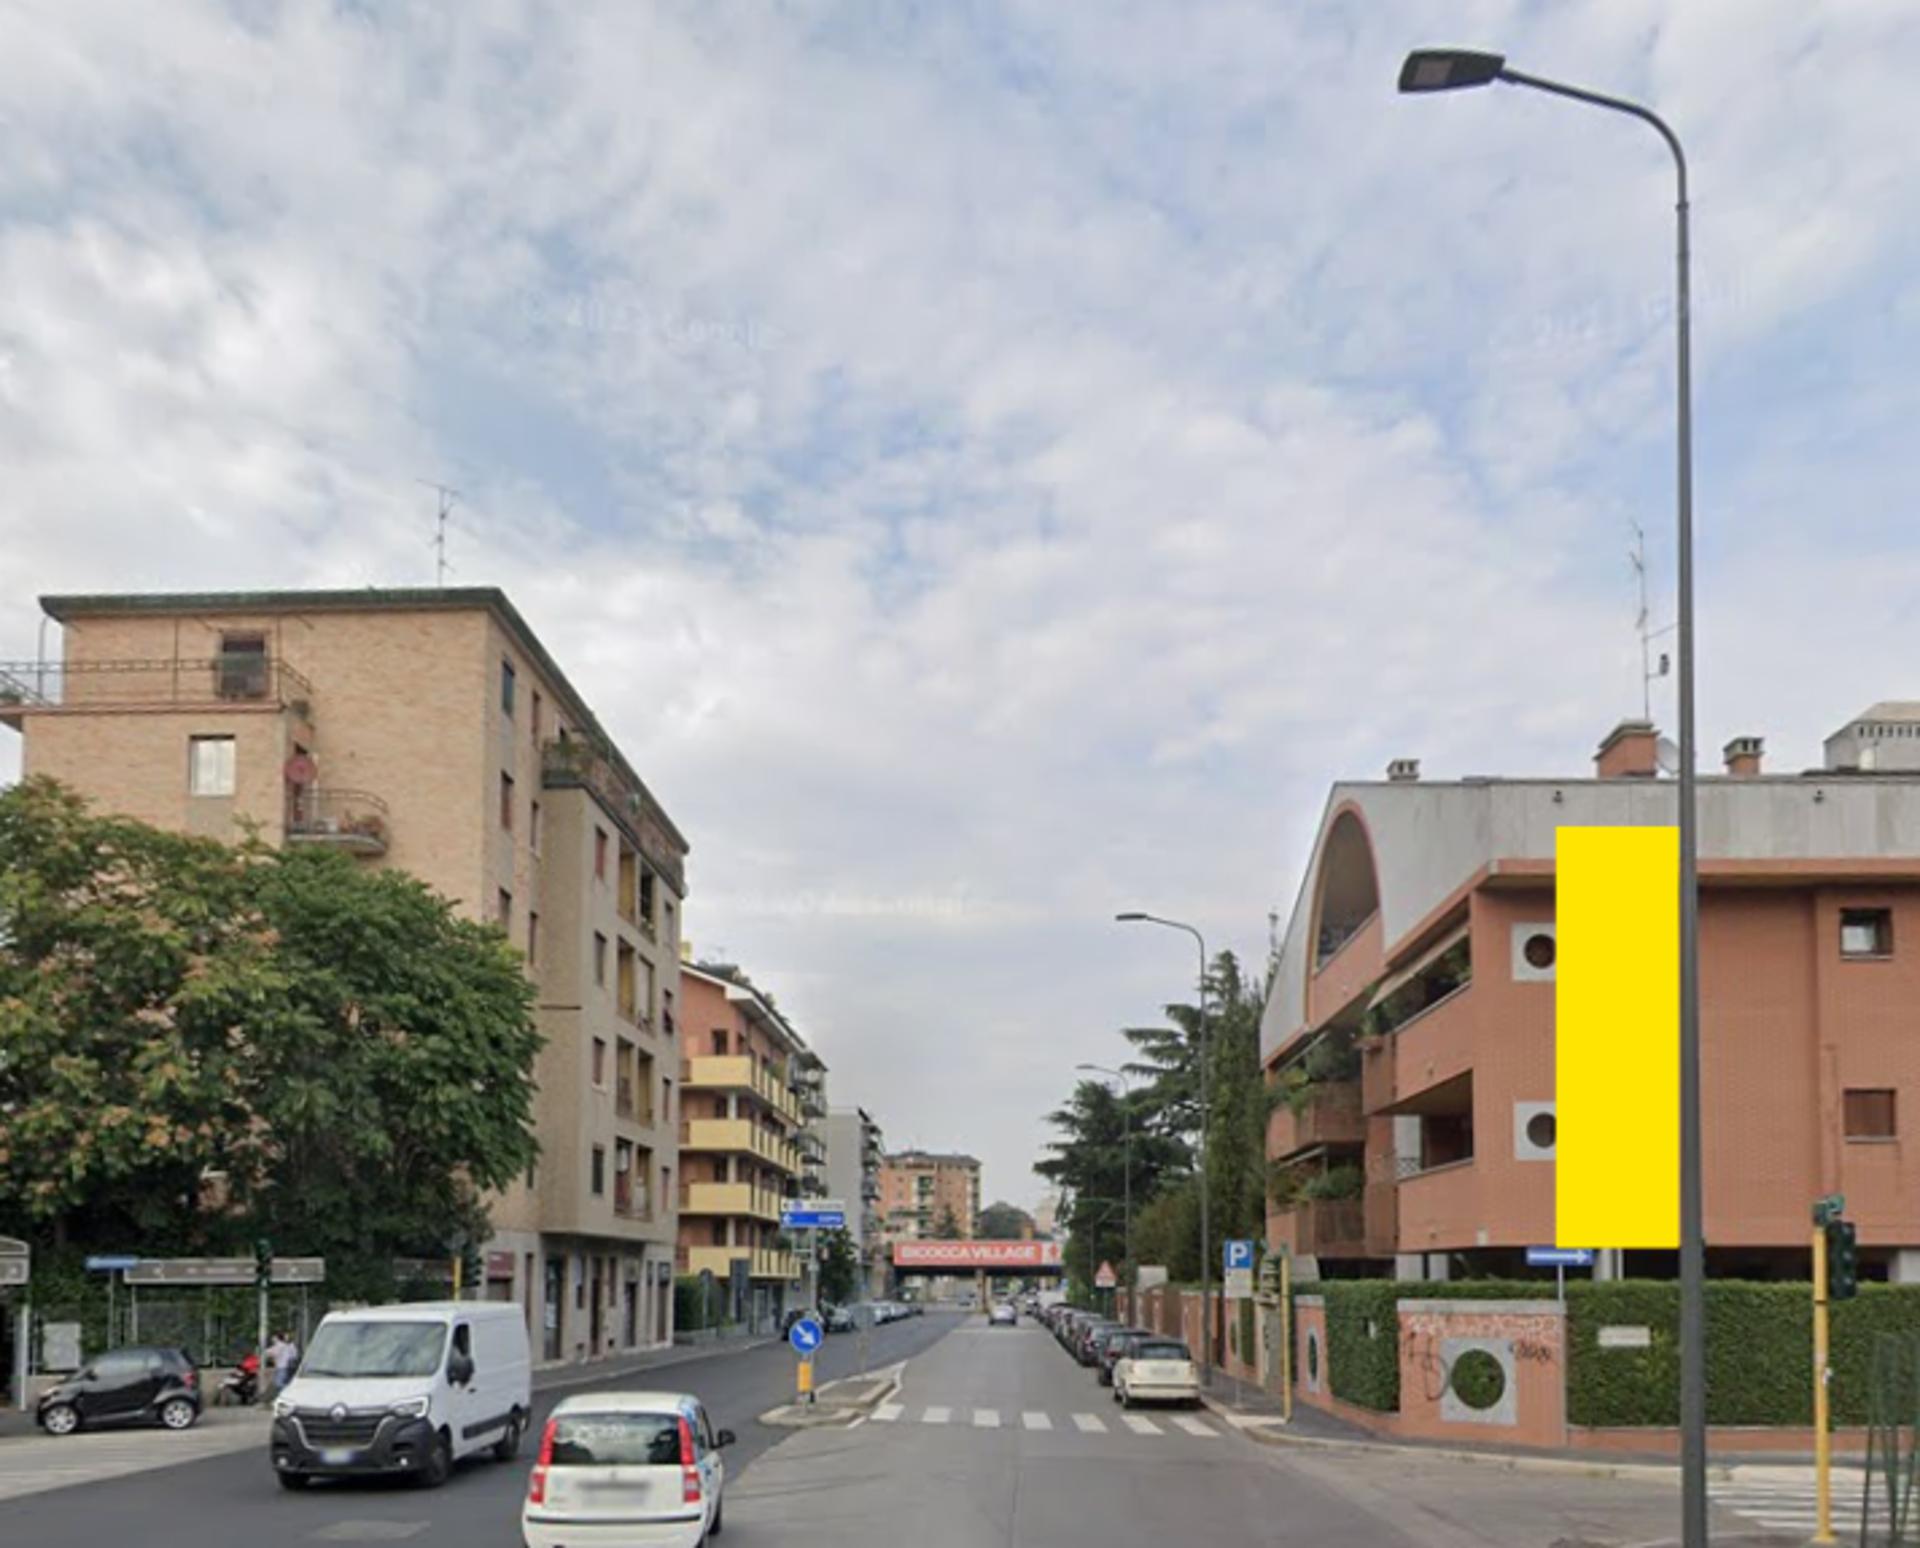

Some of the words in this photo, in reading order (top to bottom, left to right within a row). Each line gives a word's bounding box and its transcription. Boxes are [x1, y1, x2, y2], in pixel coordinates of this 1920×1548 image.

[901, 1245, 969, 1258] BICOCCA
[971, 1245, 1036, 1258] VILLAGE
[1230, 1241, 1248, 1267] P
